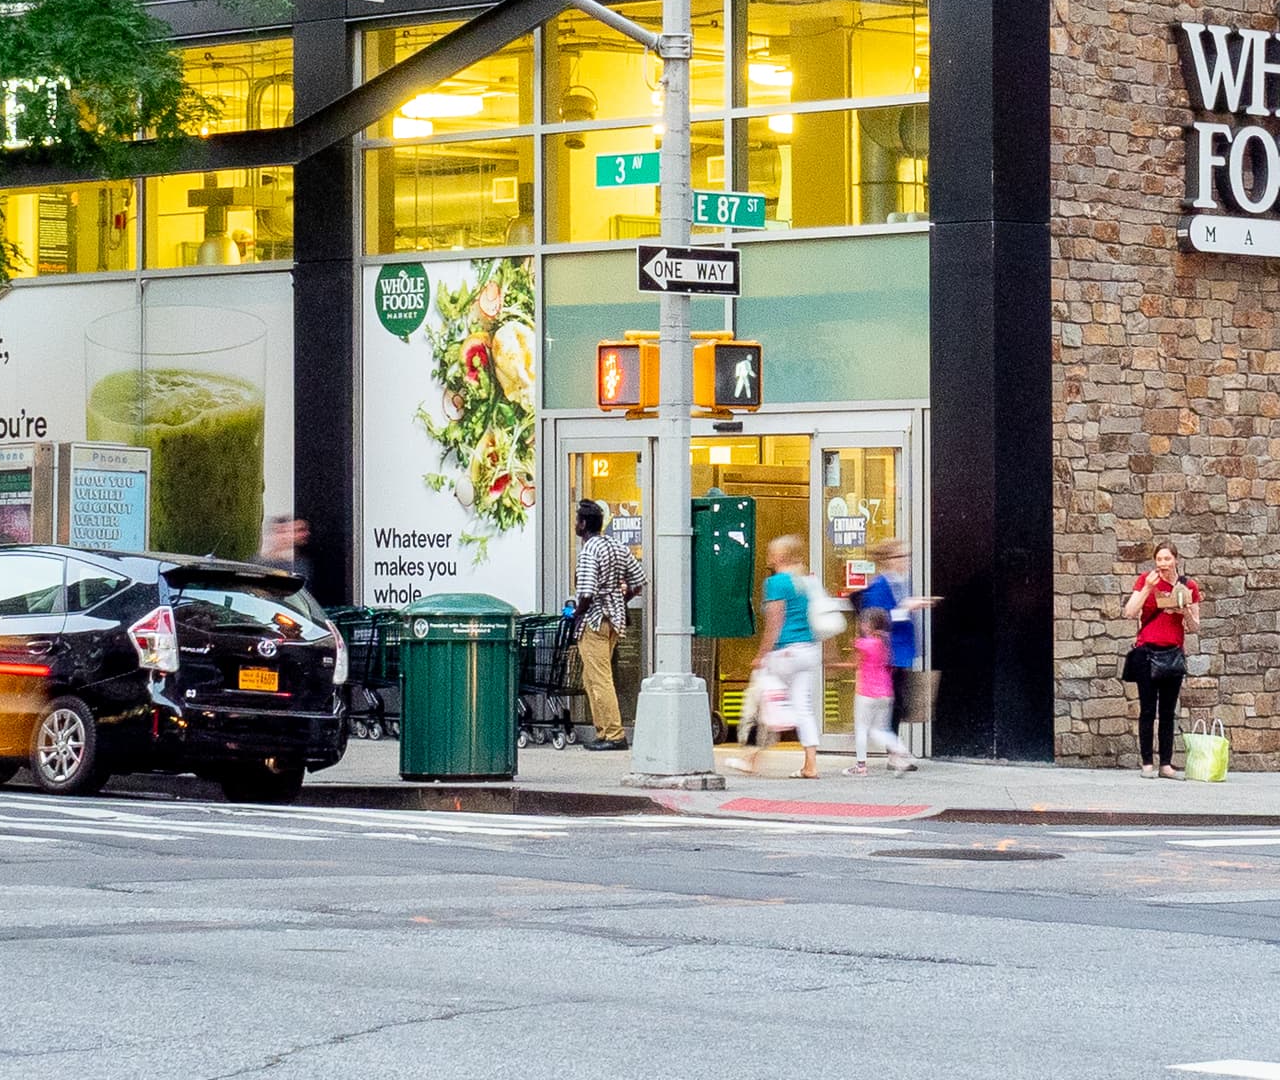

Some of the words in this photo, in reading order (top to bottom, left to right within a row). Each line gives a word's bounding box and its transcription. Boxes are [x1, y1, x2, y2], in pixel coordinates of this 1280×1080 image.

[615, 157, 626, 183] 3
[631, 155, 644, 170] AV
[697, 195, 709, 221] E
[717, 196, 740, 223] 87
[747, 198, 759, 213] ST
[654, 260, 683, 279] ONE
[696, 263, 727, 281] WAY
[380, 275, 425, 294] WHOLE
[382, 293, 425, 311] FOODS
[386, 311, 418, 320] MARKET
[91, 452, 128, 464] Phone
[592, 458, 609, 477] 12
[108, 476, 136, 488] YOU
[74, 502, 134, 514] COCONUT
[374, 527, 453, 549] Whatever
[374, 555, 425, 576] makes
[427, 560, 457, 581] you
